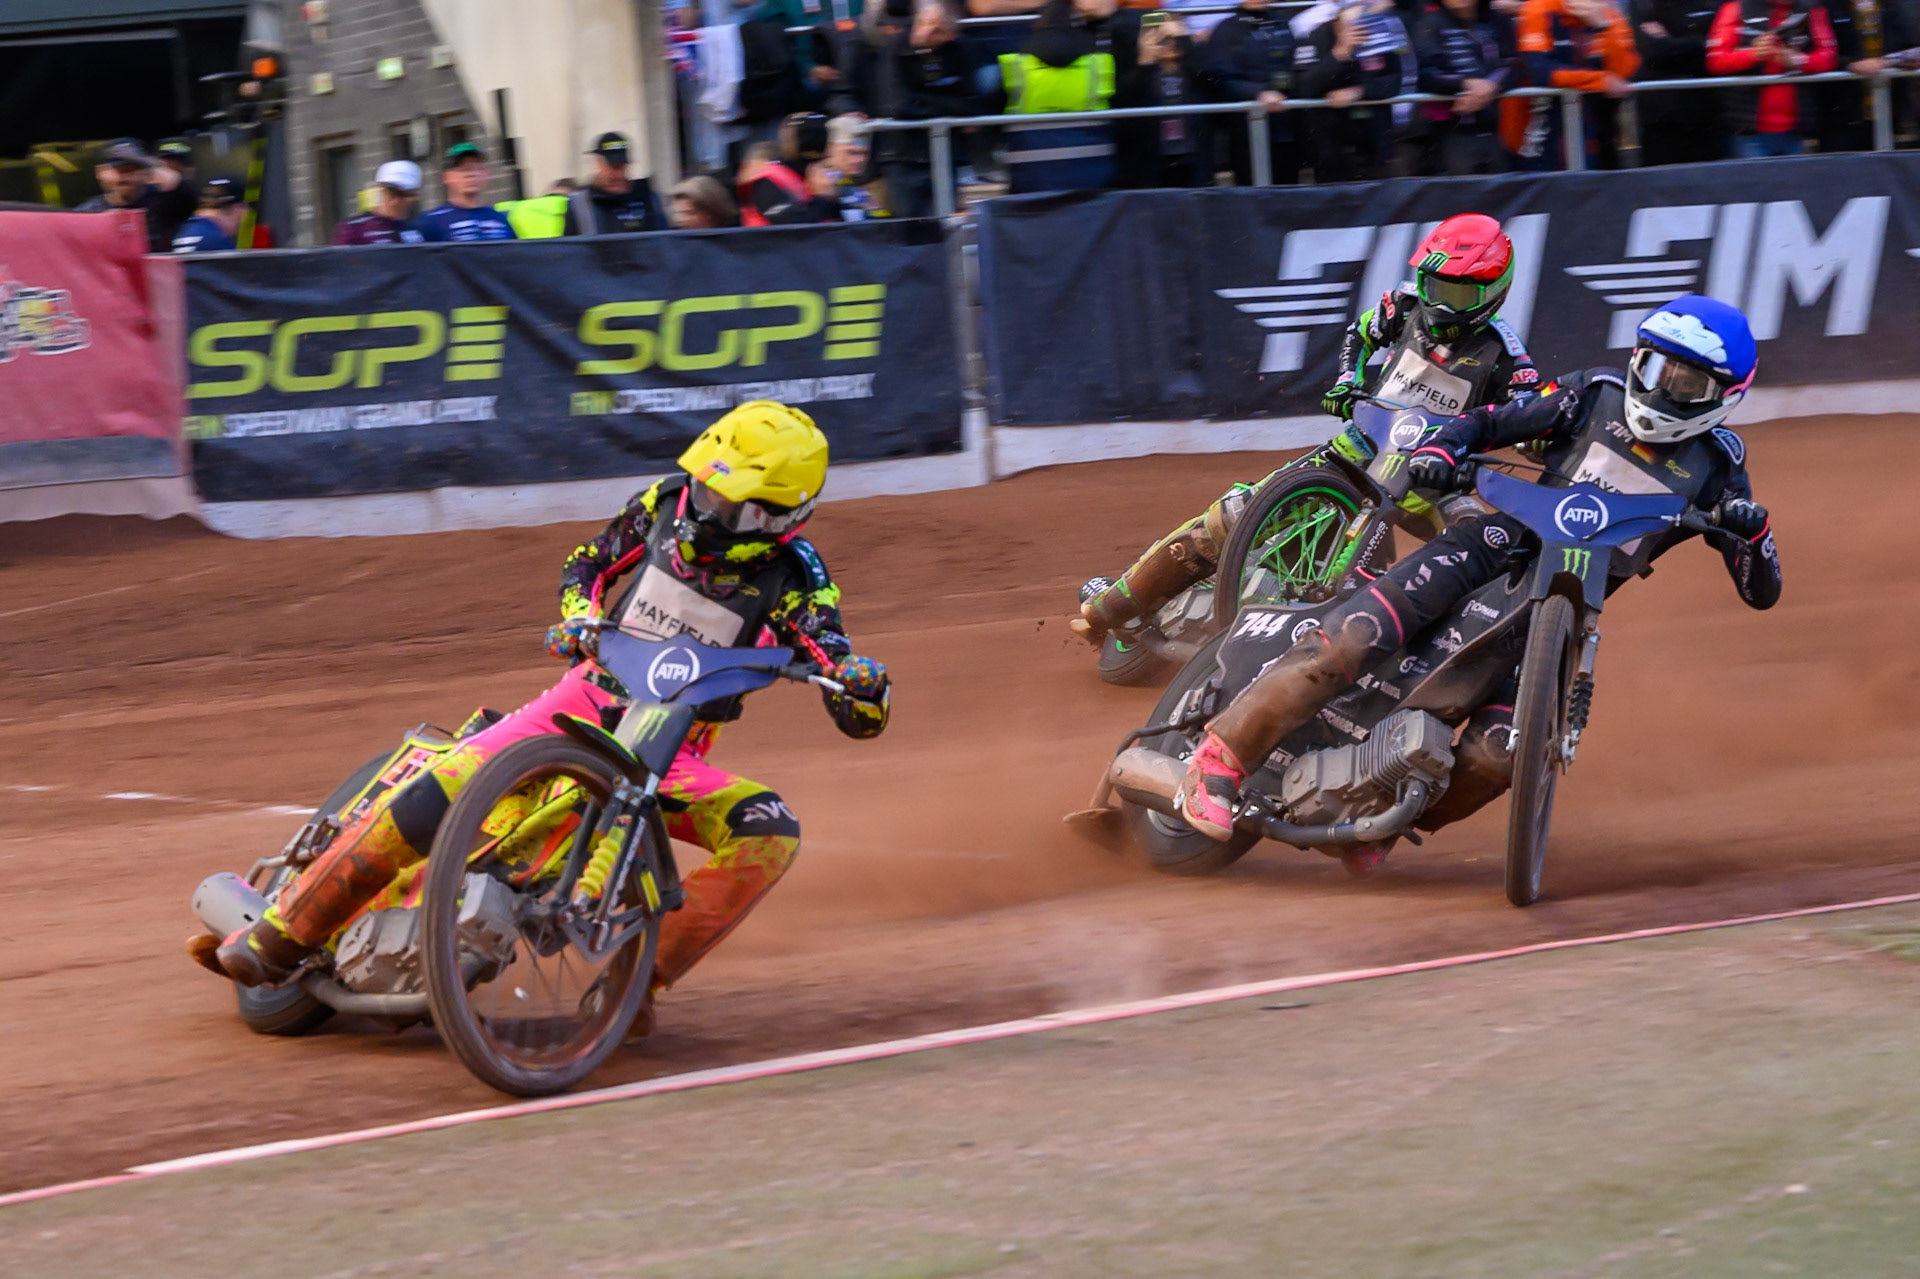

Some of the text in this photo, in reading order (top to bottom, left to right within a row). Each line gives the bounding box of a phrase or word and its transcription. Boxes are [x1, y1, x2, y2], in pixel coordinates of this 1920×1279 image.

[1564, 196, 1890, 349] FIM
[575, 291, 826, 375] SGP
[184, 309, 445, 399] SGP
[1393, 370, 1459, 411] MAYFIELD
[1394, 424, 1421, 437] ATPI
[1563, 507, 1599, 525] ATPI
[1232, 612, 1293, 638] 744
[654, 662, 690, 682] ATPI
